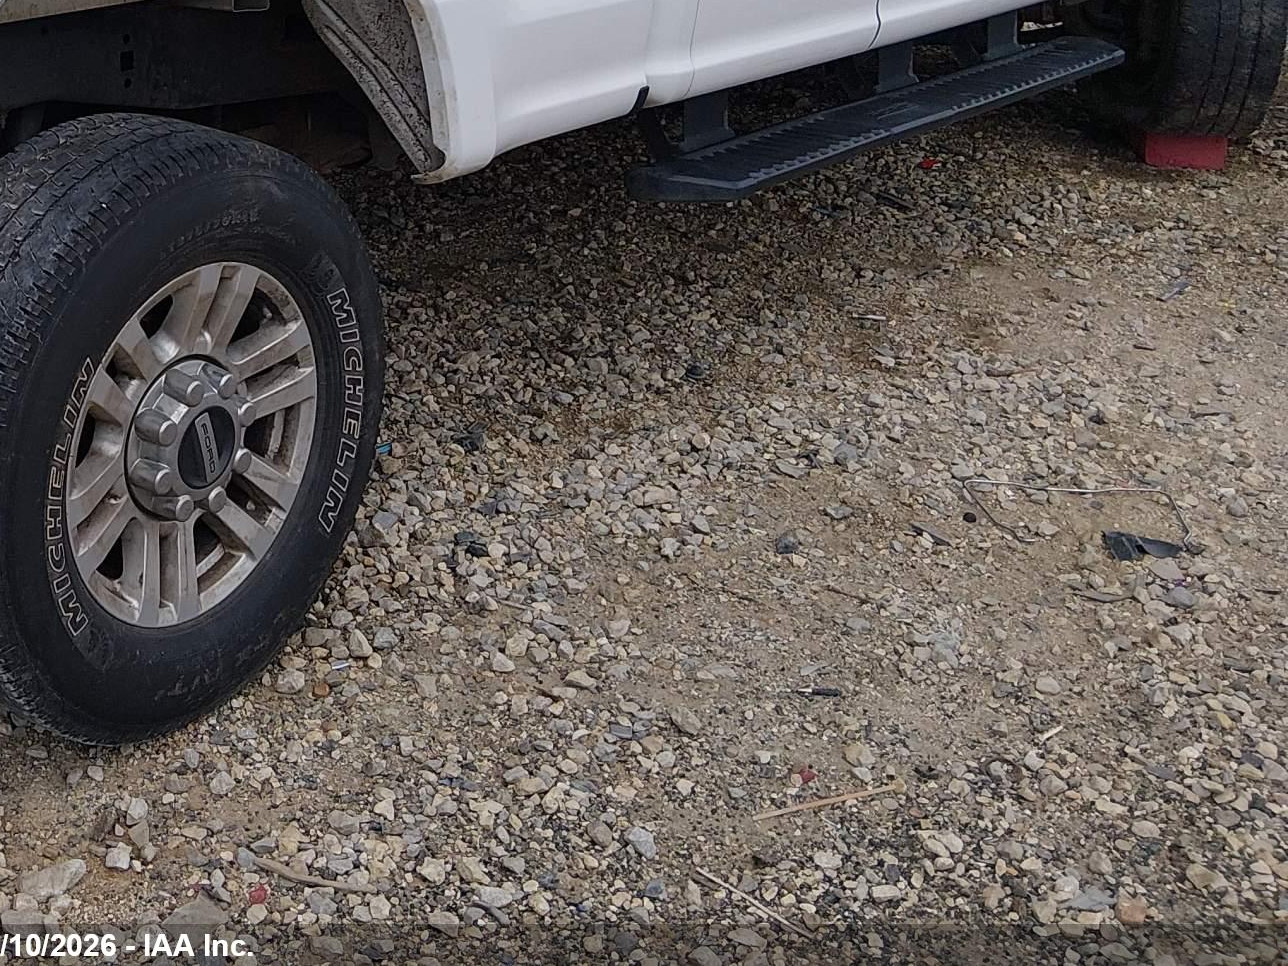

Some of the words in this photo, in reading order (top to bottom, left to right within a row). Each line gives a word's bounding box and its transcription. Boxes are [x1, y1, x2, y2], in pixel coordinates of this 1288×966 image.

[46, 356, 96, 636] MICHELIN
[200, 422, 216, 474] FORD
[317, 287, 363, 533] MICHELIN
